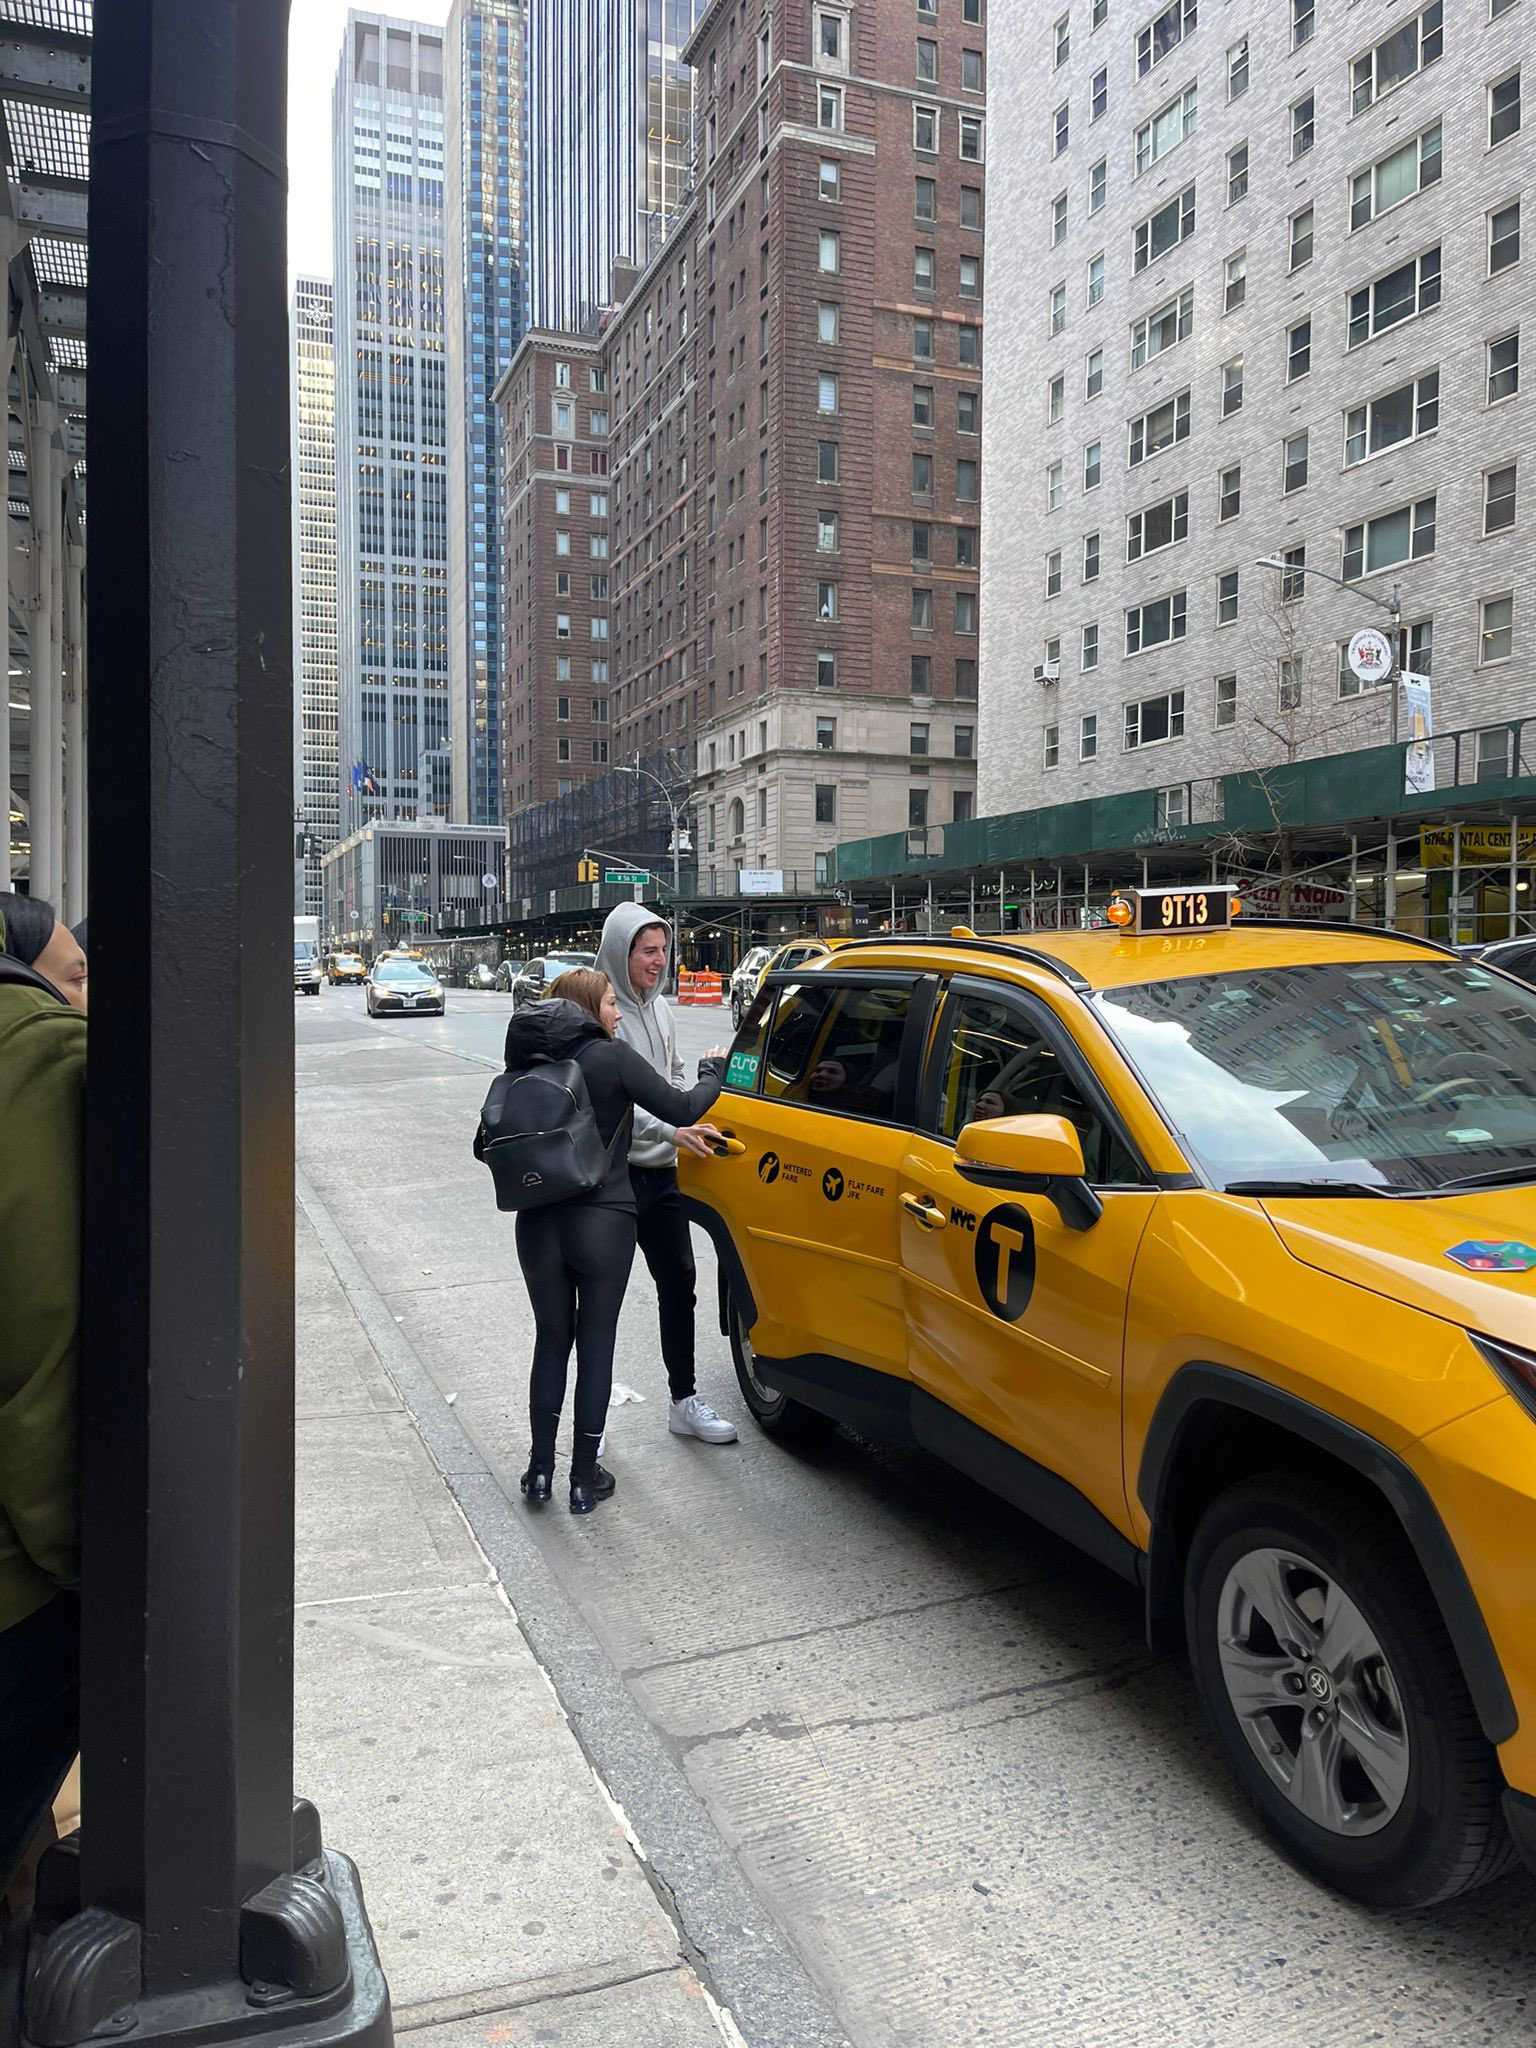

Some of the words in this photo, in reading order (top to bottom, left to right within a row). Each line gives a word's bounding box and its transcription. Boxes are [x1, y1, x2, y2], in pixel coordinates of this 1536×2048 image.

[1447, 831, 1487, 848] RNTAL
[1161, 894, 1208, 927] 9T13
[730, 1055, 758, 1073] curb
[781, 1172, 799, 1184] FARE
[783, 1163, 813, 1178] METERED
[847, 1190, 860, 1200] JFK
[848, 1179, 864, 1191] FLAT
[865, 1184, 885, 1196] FARE
[950, 1206, 977, 1232] NYC
[990, 1221, 1024, 1305] T
